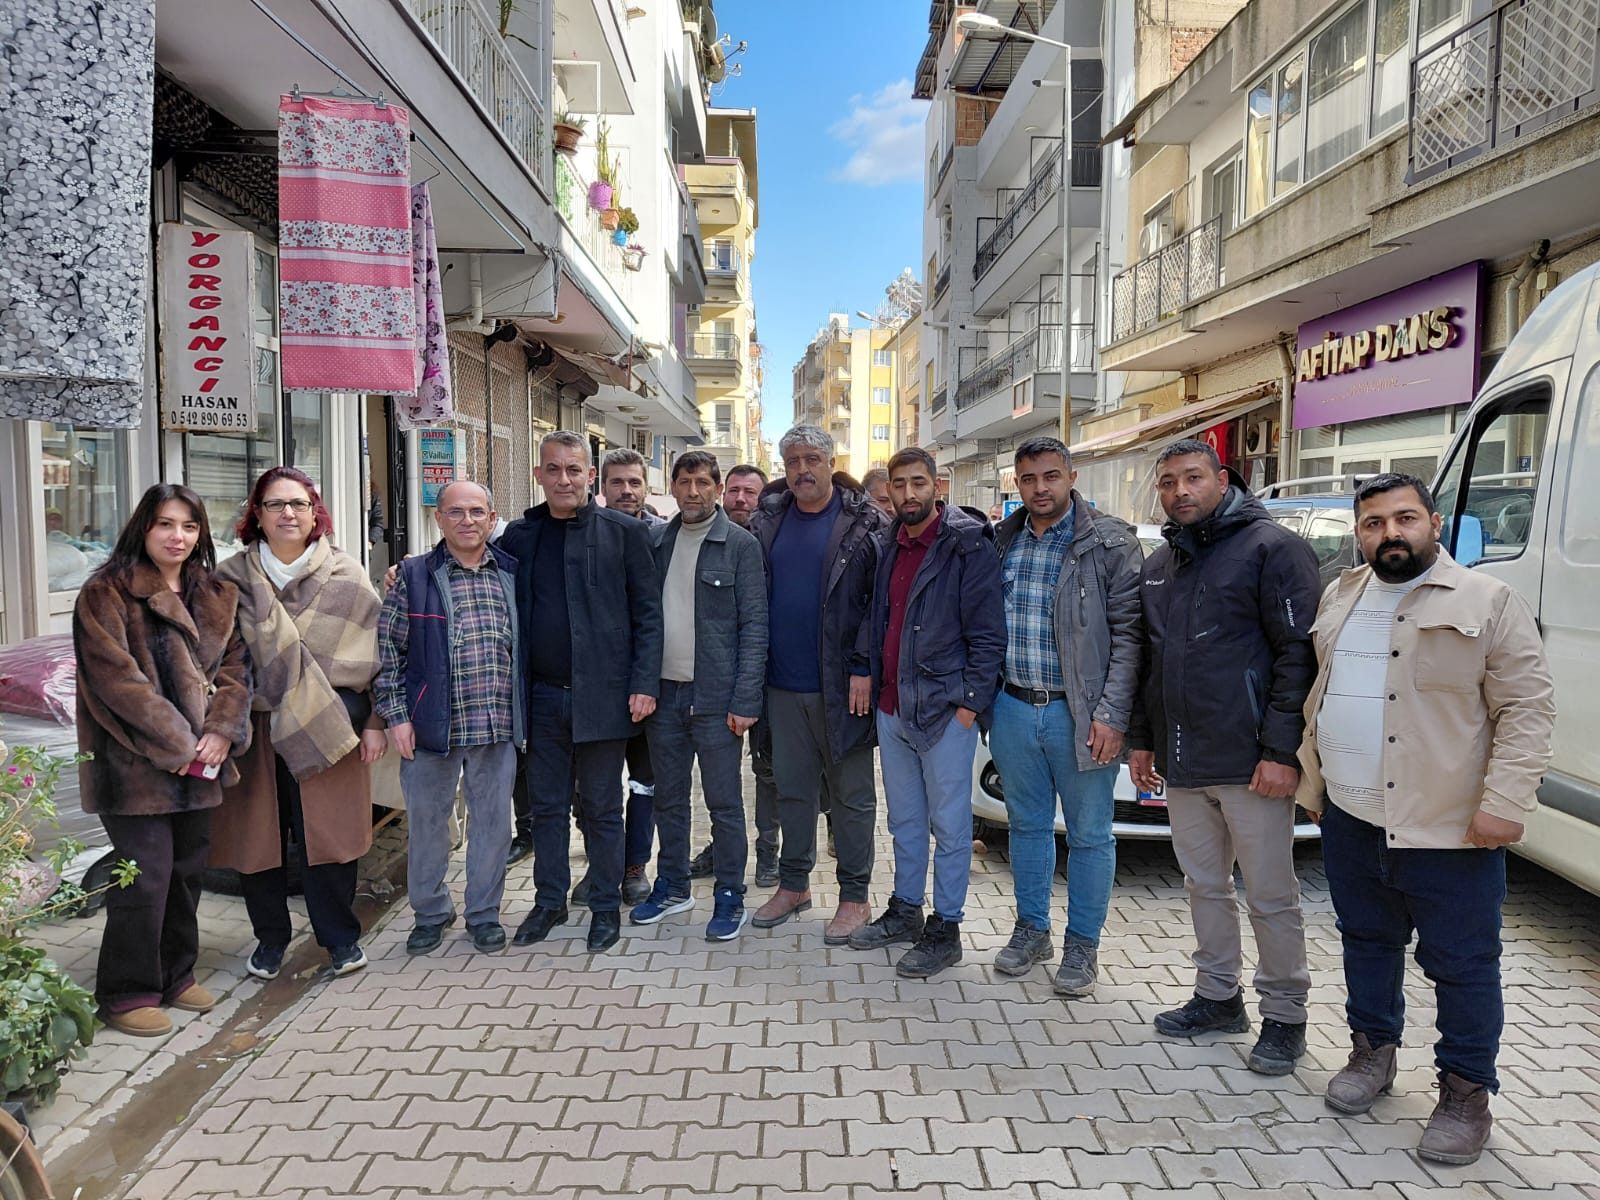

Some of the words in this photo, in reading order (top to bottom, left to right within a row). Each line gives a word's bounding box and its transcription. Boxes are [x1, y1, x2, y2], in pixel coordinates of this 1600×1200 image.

[187, 231, 228, 393] YORGANCI
[1296, 330, 1373, 383] AFİTAP
[1375, 306, 1454, 362] DANS
[181, 395, 238, 410] HASAN
[171, 411, 177, 425] 0
[180, 411, 198, 425] 542
[201, 412, 219, 426] 890
[221, 413, 233, 427] 69
[236, 413, 248, 427] 53
[429, 450, 453, 460] Vaillant
[1285, 598, 1295, 628] Outdoor
